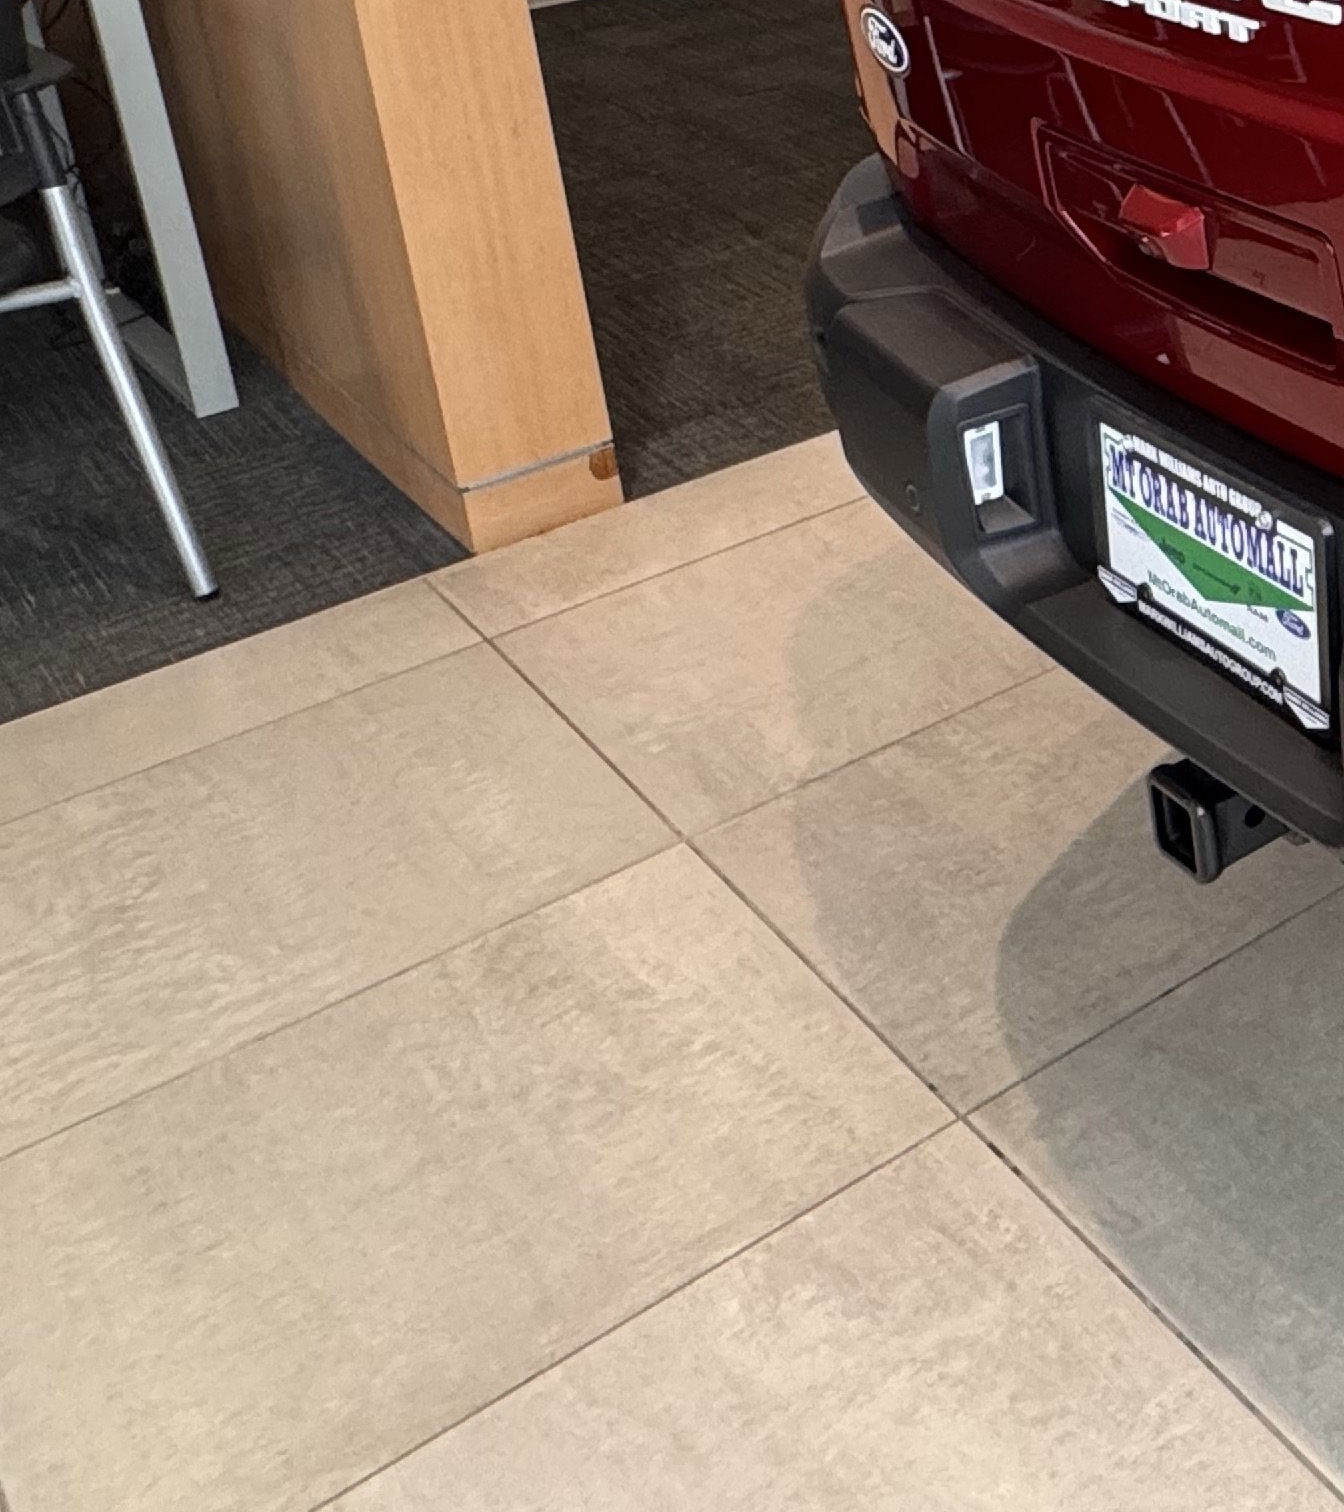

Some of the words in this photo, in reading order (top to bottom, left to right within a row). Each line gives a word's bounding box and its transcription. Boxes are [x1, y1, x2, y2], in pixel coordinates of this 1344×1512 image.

[866, 14, 900, 66] Ford
[1110, 444, 1137, 498] MT
[1140, 460, 1190, 530] ORAB
[1195, 492, 1304, 598] AUTOMALL
